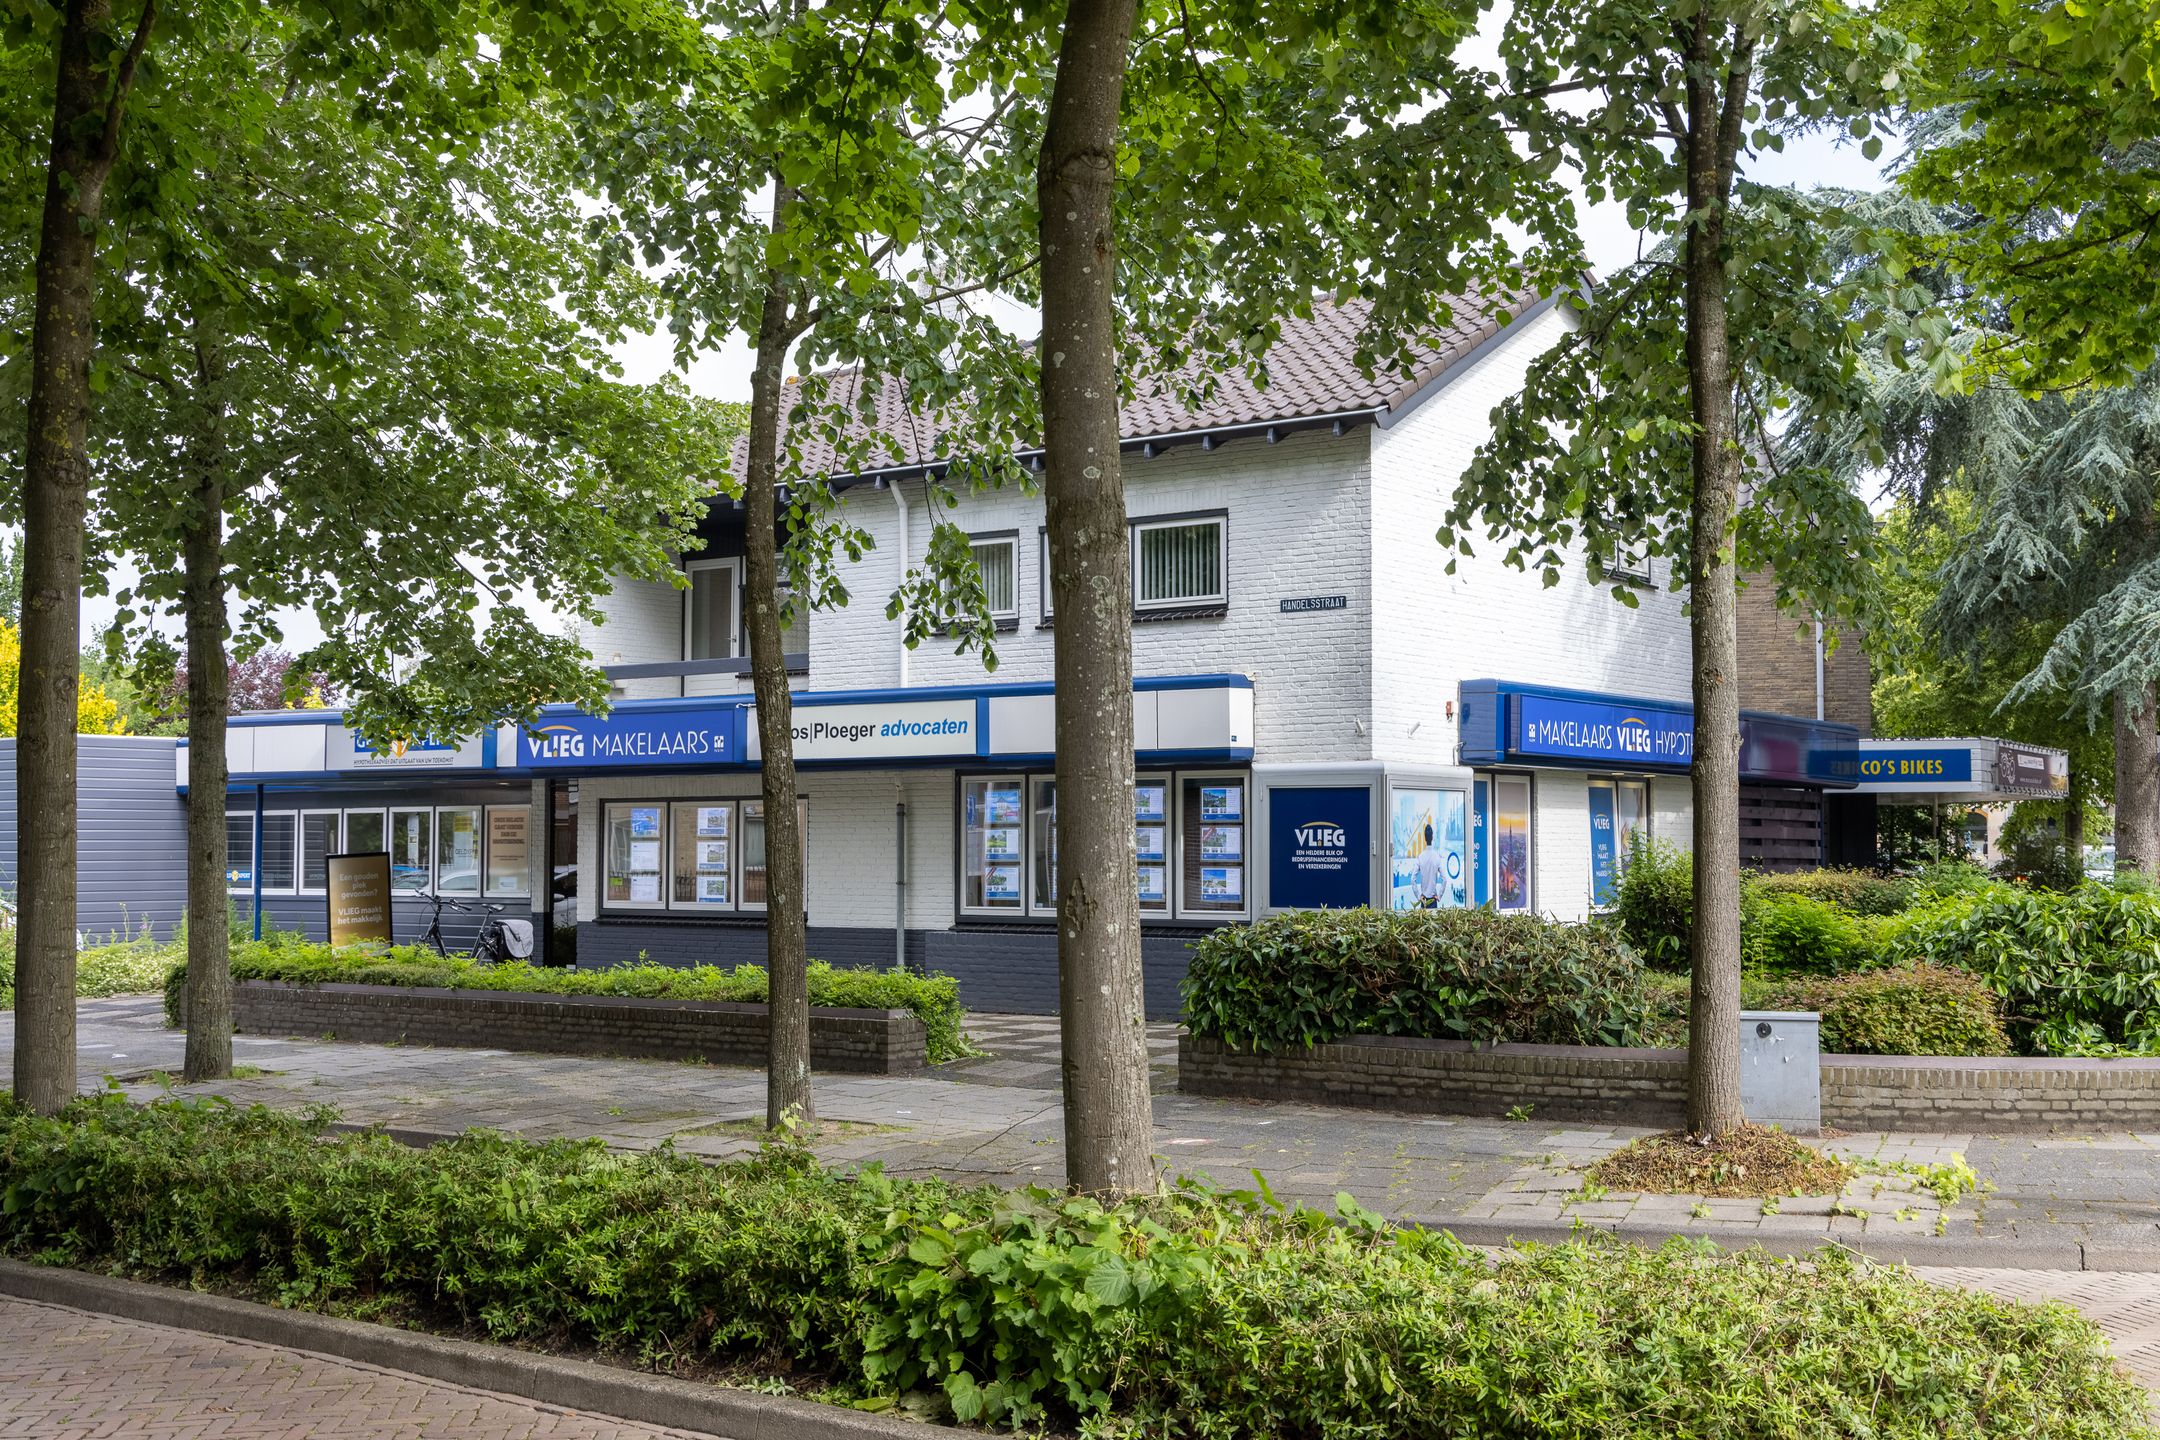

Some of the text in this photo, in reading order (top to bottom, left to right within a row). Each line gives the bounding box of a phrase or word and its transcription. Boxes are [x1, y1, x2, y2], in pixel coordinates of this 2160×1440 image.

[1282, 597, 1344, 610] HANDELSSTRAAT
[791, 718, 968, 743] os|Ploeger advocaten
[1539, 720, 1612, 750] MAKELAARS
[1617, 727, 1650, 752] VLIEG
[528, 731, 709, 758] VLIEG MAKELAARS
[1900, 760, 1943, 775] BIKES
[1593, 817, 1610, 830] VLIEG
[1294, 828, 1346, 847] VLIEG
[339, 872, 379, 882] Een gouden
[352, 881, 367, 891] plek
[341, 889, 378, 899] gevonden?
[338, 907, 360, 915] VLIEG
